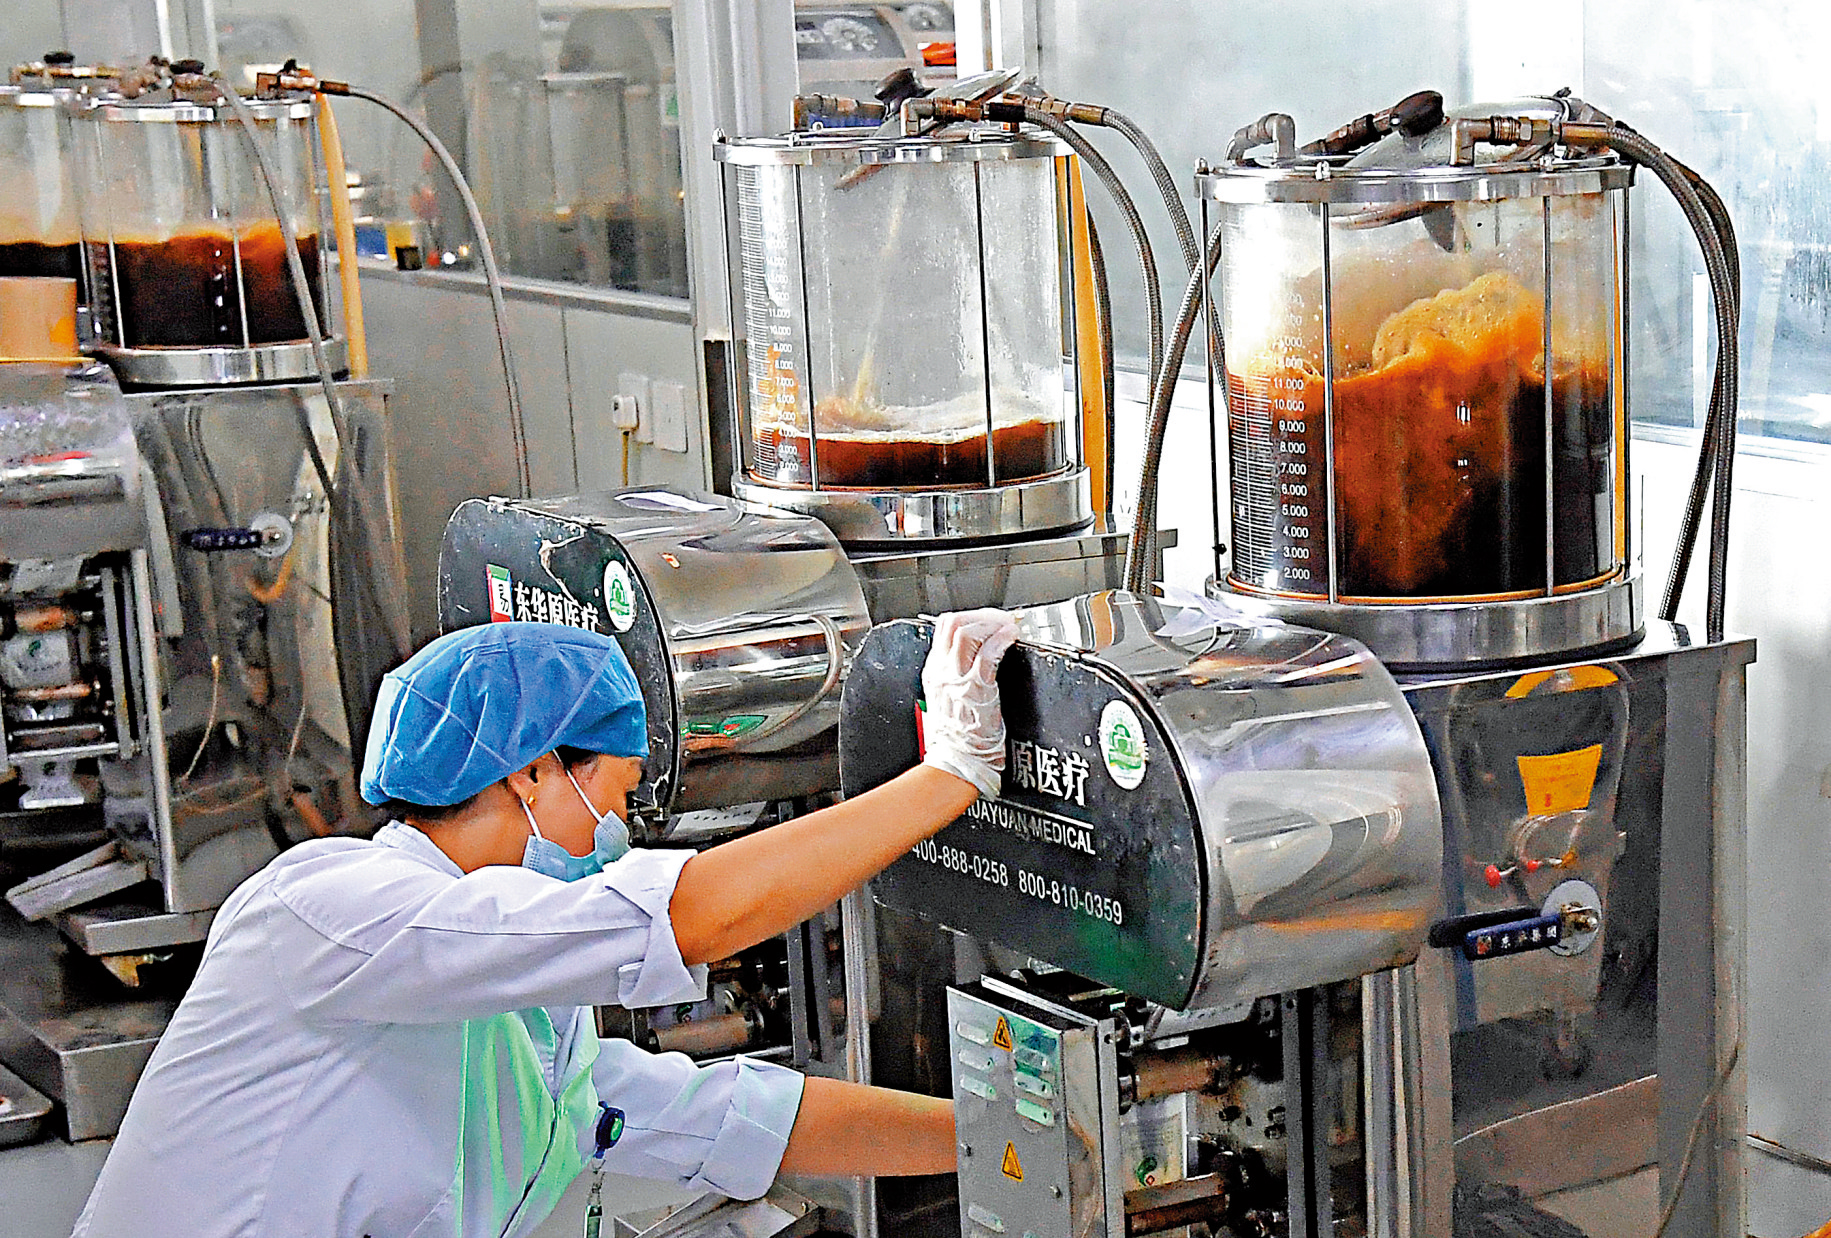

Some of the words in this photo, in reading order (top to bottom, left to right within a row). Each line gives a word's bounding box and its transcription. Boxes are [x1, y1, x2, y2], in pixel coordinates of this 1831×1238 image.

[770, 325, 791, 336] 10.000
[1273, 377, 1304, 390] 11.000
[1274, 399, 1305, 411] 10.000
[1279, 420, 1305, 433] 9.000
[1280, 441, 1306, 454] 8.000
[1281, 462, 1307, 475] 7.000
[1281, 483, 1308, 496] 6.000
[1282, 504, 1308, 517] 5.000
[1282, 525, 1309, 538] 4.000
[1283, 546, 1310, 559] 3.000
[1284, 567, 1310, 580] 2.000
[1028, 815, 1096, 855] MEDICAL
[912, 839, 1009, 887] 400-888-0258
[1018, 869, 1123, 925] 800-810-0359
